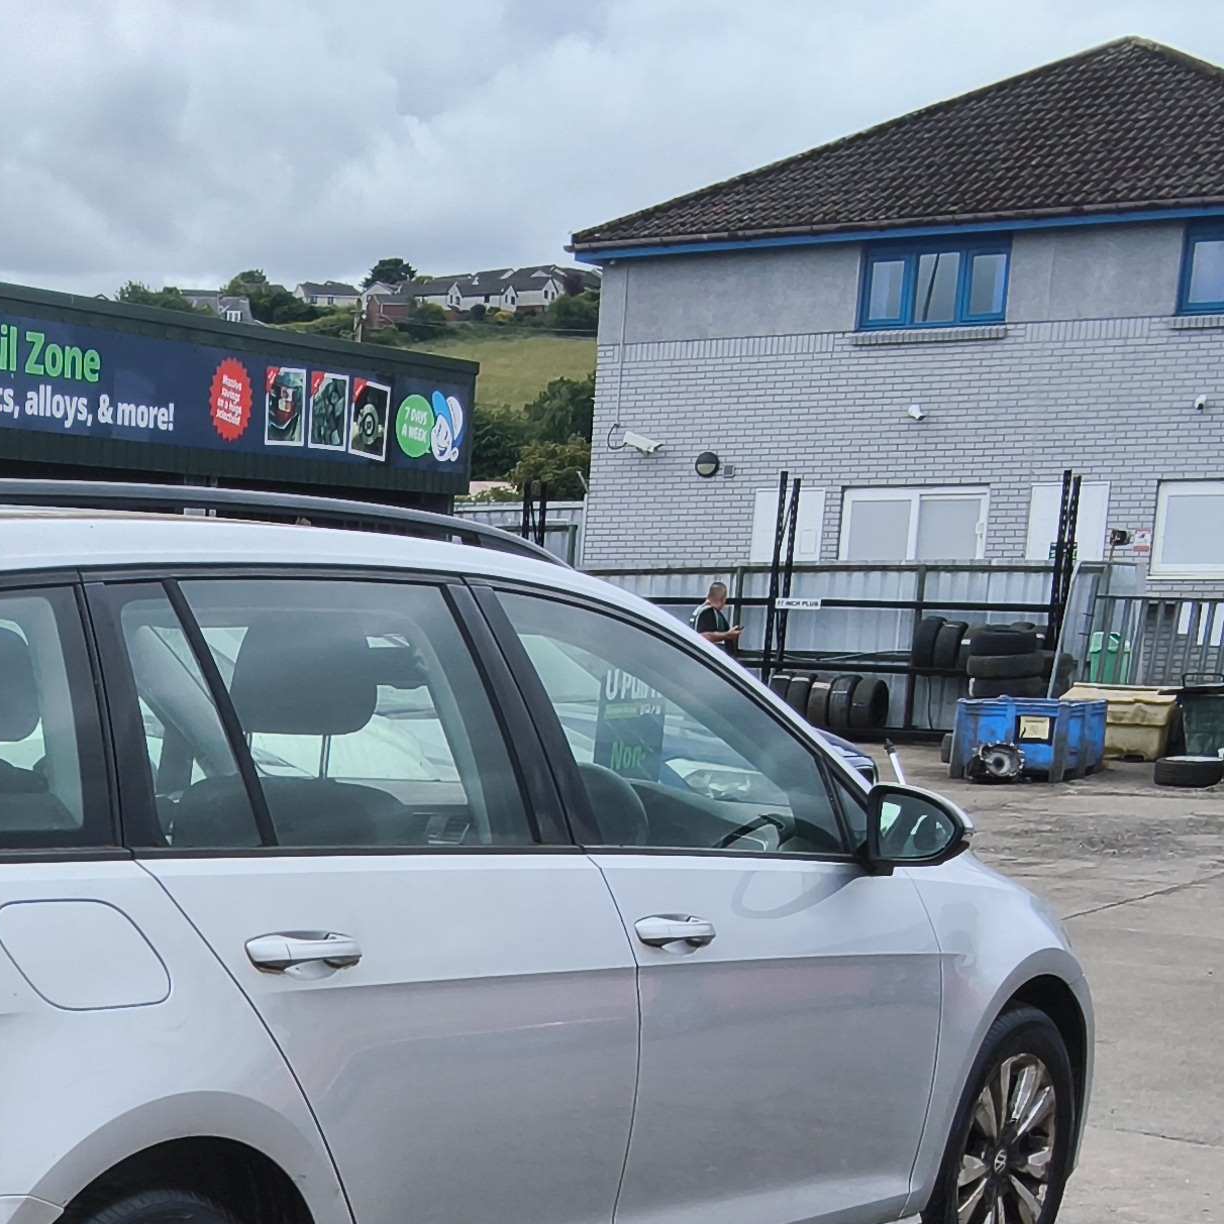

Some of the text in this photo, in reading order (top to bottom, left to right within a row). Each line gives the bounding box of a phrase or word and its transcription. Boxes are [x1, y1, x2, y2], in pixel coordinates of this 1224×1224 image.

[25, 330, 101, 383] Zone
[222, 374, 242, 391] Massive
[25, 385, 92, 429] alloys,
[97, 394, 113, 425] &
[116, 402, 174, 432] more!
[404, 406, 411, 420] 7
[411, 408, 428, 426] DAYS
[401, 423, 428, 444] A WEEK
